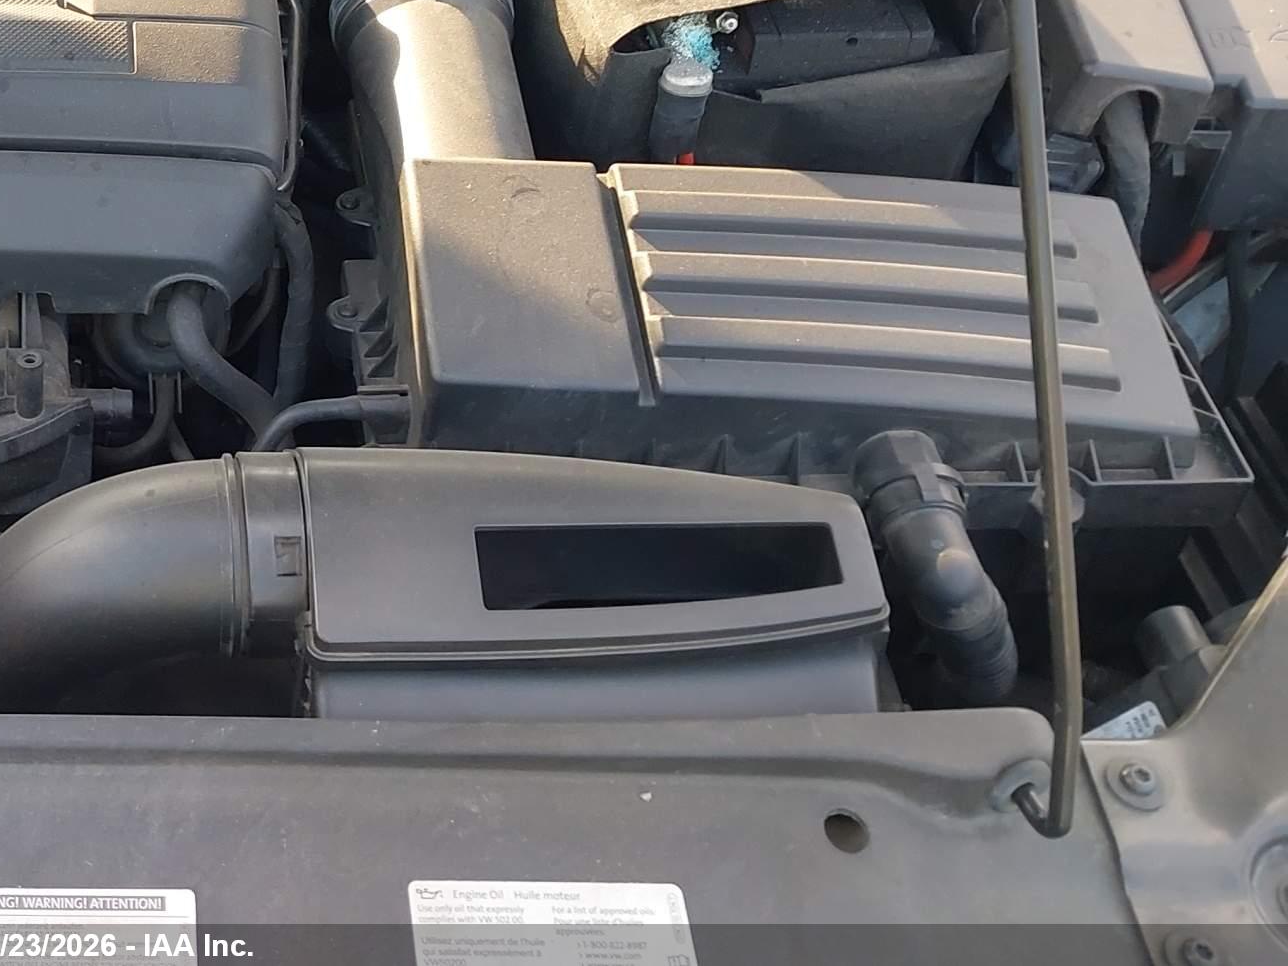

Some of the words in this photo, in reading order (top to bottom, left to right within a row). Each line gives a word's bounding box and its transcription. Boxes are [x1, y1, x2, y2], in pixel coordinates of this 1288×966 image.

[452, 889, 488, 901] Engine
[489, 889, 504, 899] Oil
[513, 889, 541, 900] Huile
[543, 891, 581, 901] moteur
[22, 896, 87, 909] WARNING!
[89, 897, 162, 910] ATTENTION!
